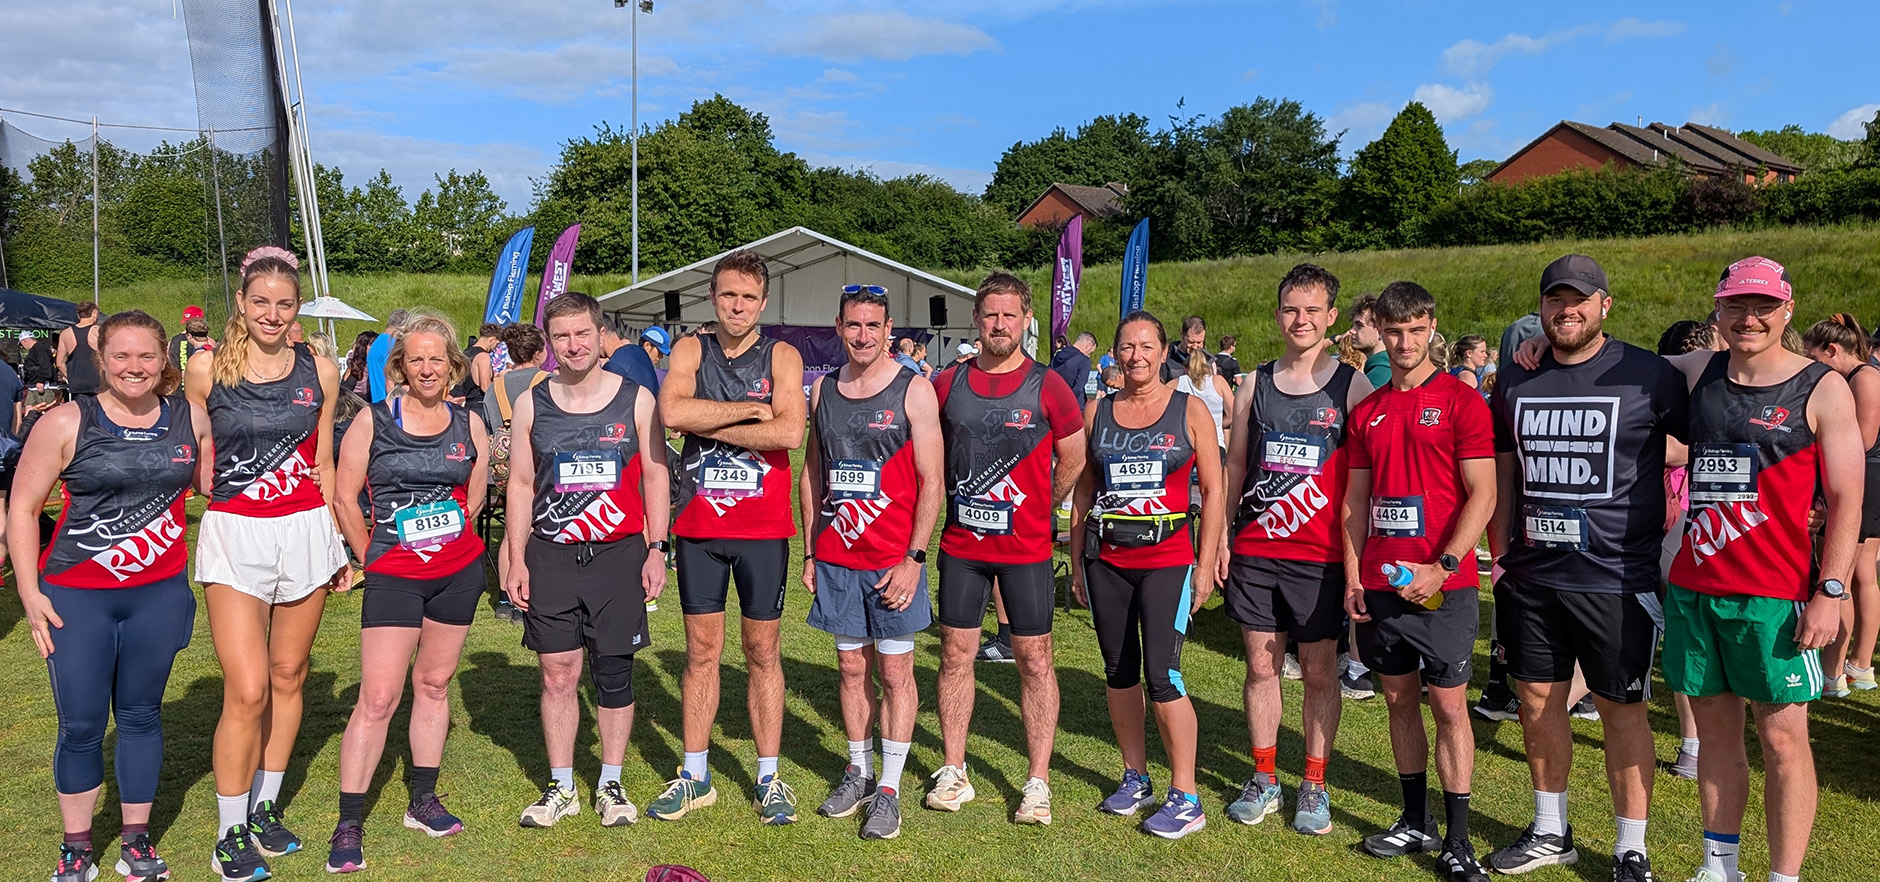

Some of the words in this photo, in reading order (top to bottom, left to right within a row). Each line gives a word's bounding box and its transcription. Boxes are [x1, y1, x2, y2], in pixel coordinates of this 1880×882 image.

[507, 251, 520, 283] Fleming
[502, 284, 514, 309] Bishop
[1132, 280, 1141, 309] Bishop
[1521, 409, 1607, 436] MIND
[251, 434, 292, 472] EXETERCITY
[263, 444, 293, 473] COMMUNITY
[292, 430, 310, 444] TRUST
[1099, 427, 1163, 453] LUCY
[1276, 443, 1307, 457] 7174
[1527, 440, 1597, 453] OVER
[570, 462, 604, 475] 7195
[1119, 462, 1153, 475] 4637
[1280, 456, 1296, 464] BEN
[1525, 456, 1600, 485] MND.
[1698, 458, 1738, 472] 2993
[713, 469, 748, 481] 7349
[835, 471, 865, 483] 1699
[966, 458, 1004, 492] EXETERCITY
[975, 469, 1004, 495] COMMUNITY
[1004, 453, 1020, 469] TRUST
[111, 493, 166, 532] EXETERCITY
[125, 504, 165, 533] COMMUNITY
[165, 487, 183, 507] TRUST
[830, 489, 893, 550] RUN
[965, 508, 1000, 522] 4009
[1257, 475, 1329, 540] RUN
[1376, 508, 1409, 521] 4484
[415, 513, 450, 531] 8133
[1534, 518, 1566, 533] 1514
[1688, 501, 1769, 566] RUN
[91, 508, 183, 583] RUN
